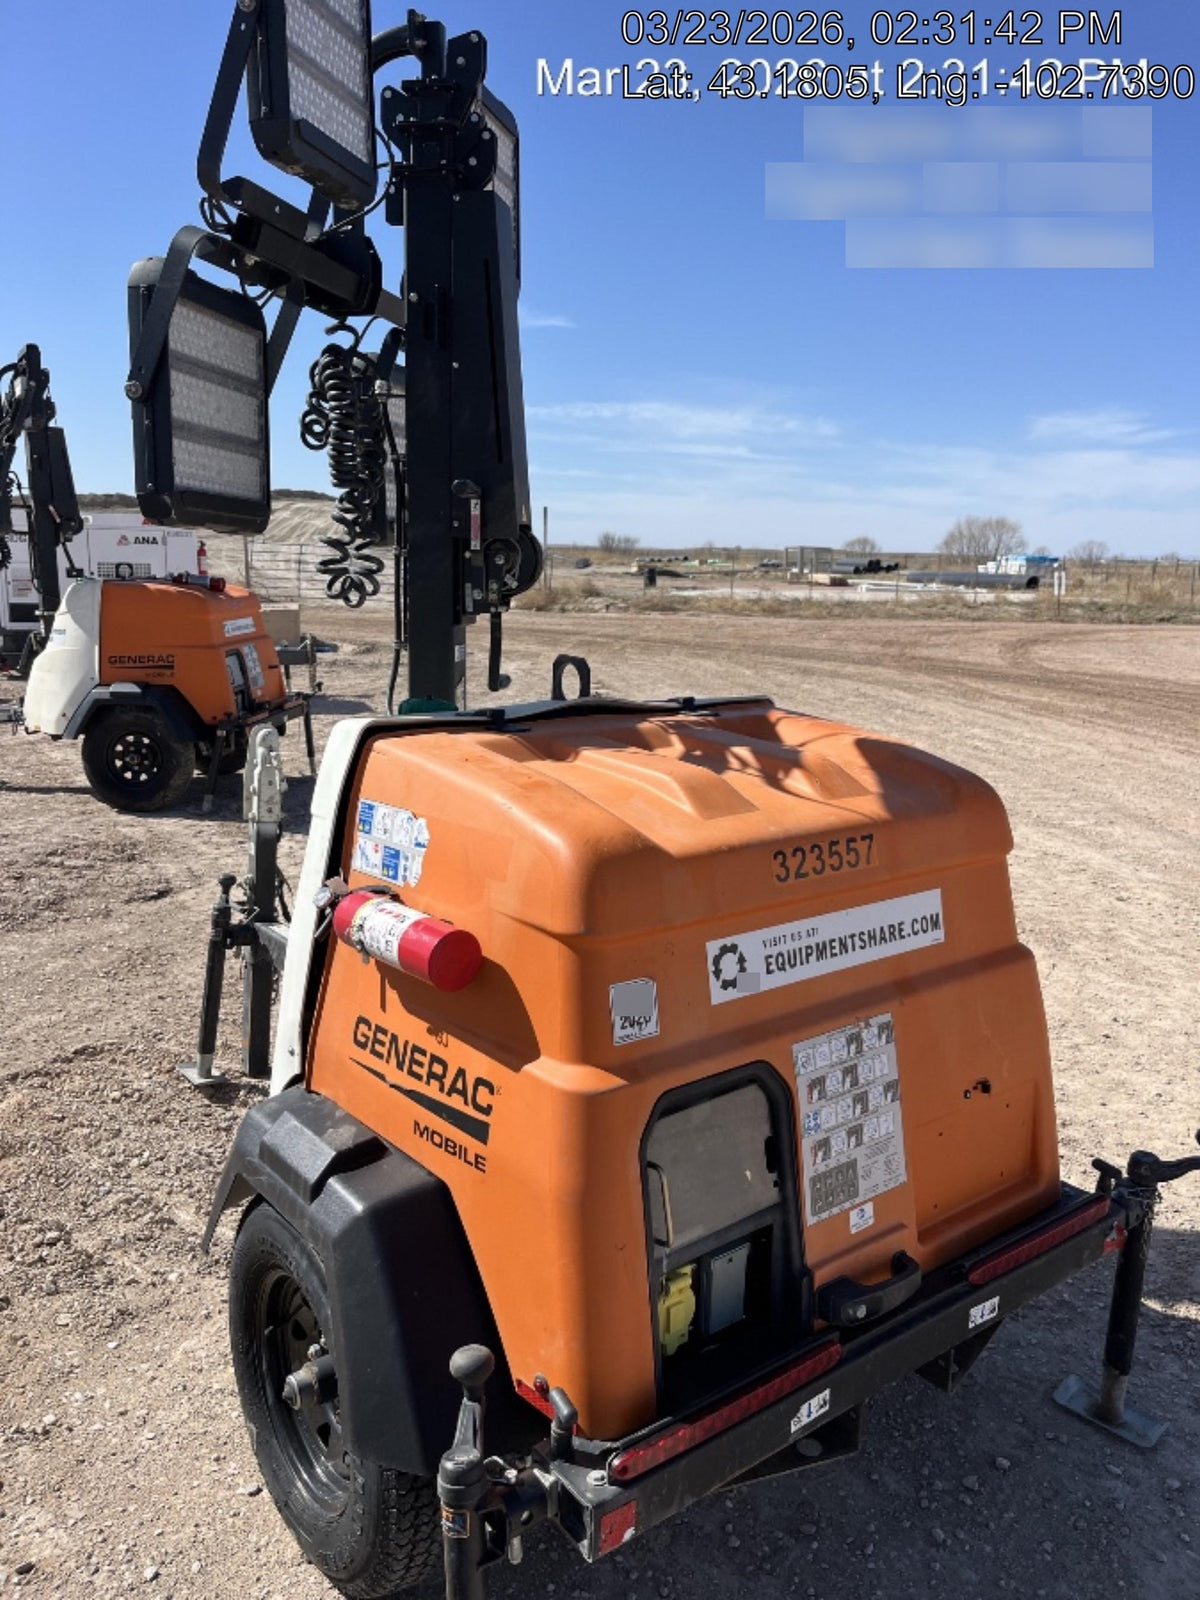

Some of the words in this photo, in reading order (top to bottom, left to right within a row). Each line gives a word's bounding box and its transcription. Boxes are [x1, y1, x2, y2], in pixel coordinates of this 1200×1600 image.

[133, 536, 159, 545] ANA
[108, 654, 175, 665] GENERAC
[773, 833, 875, 883] 323557
[762, 934, 787, 949] VISIT
[764, 912, 942, 976] EQUIPMENTSHARE.COM
[353, 1014, 495, 1117] GENERAC
[413, 1119, 487, 1174] MOBILE
